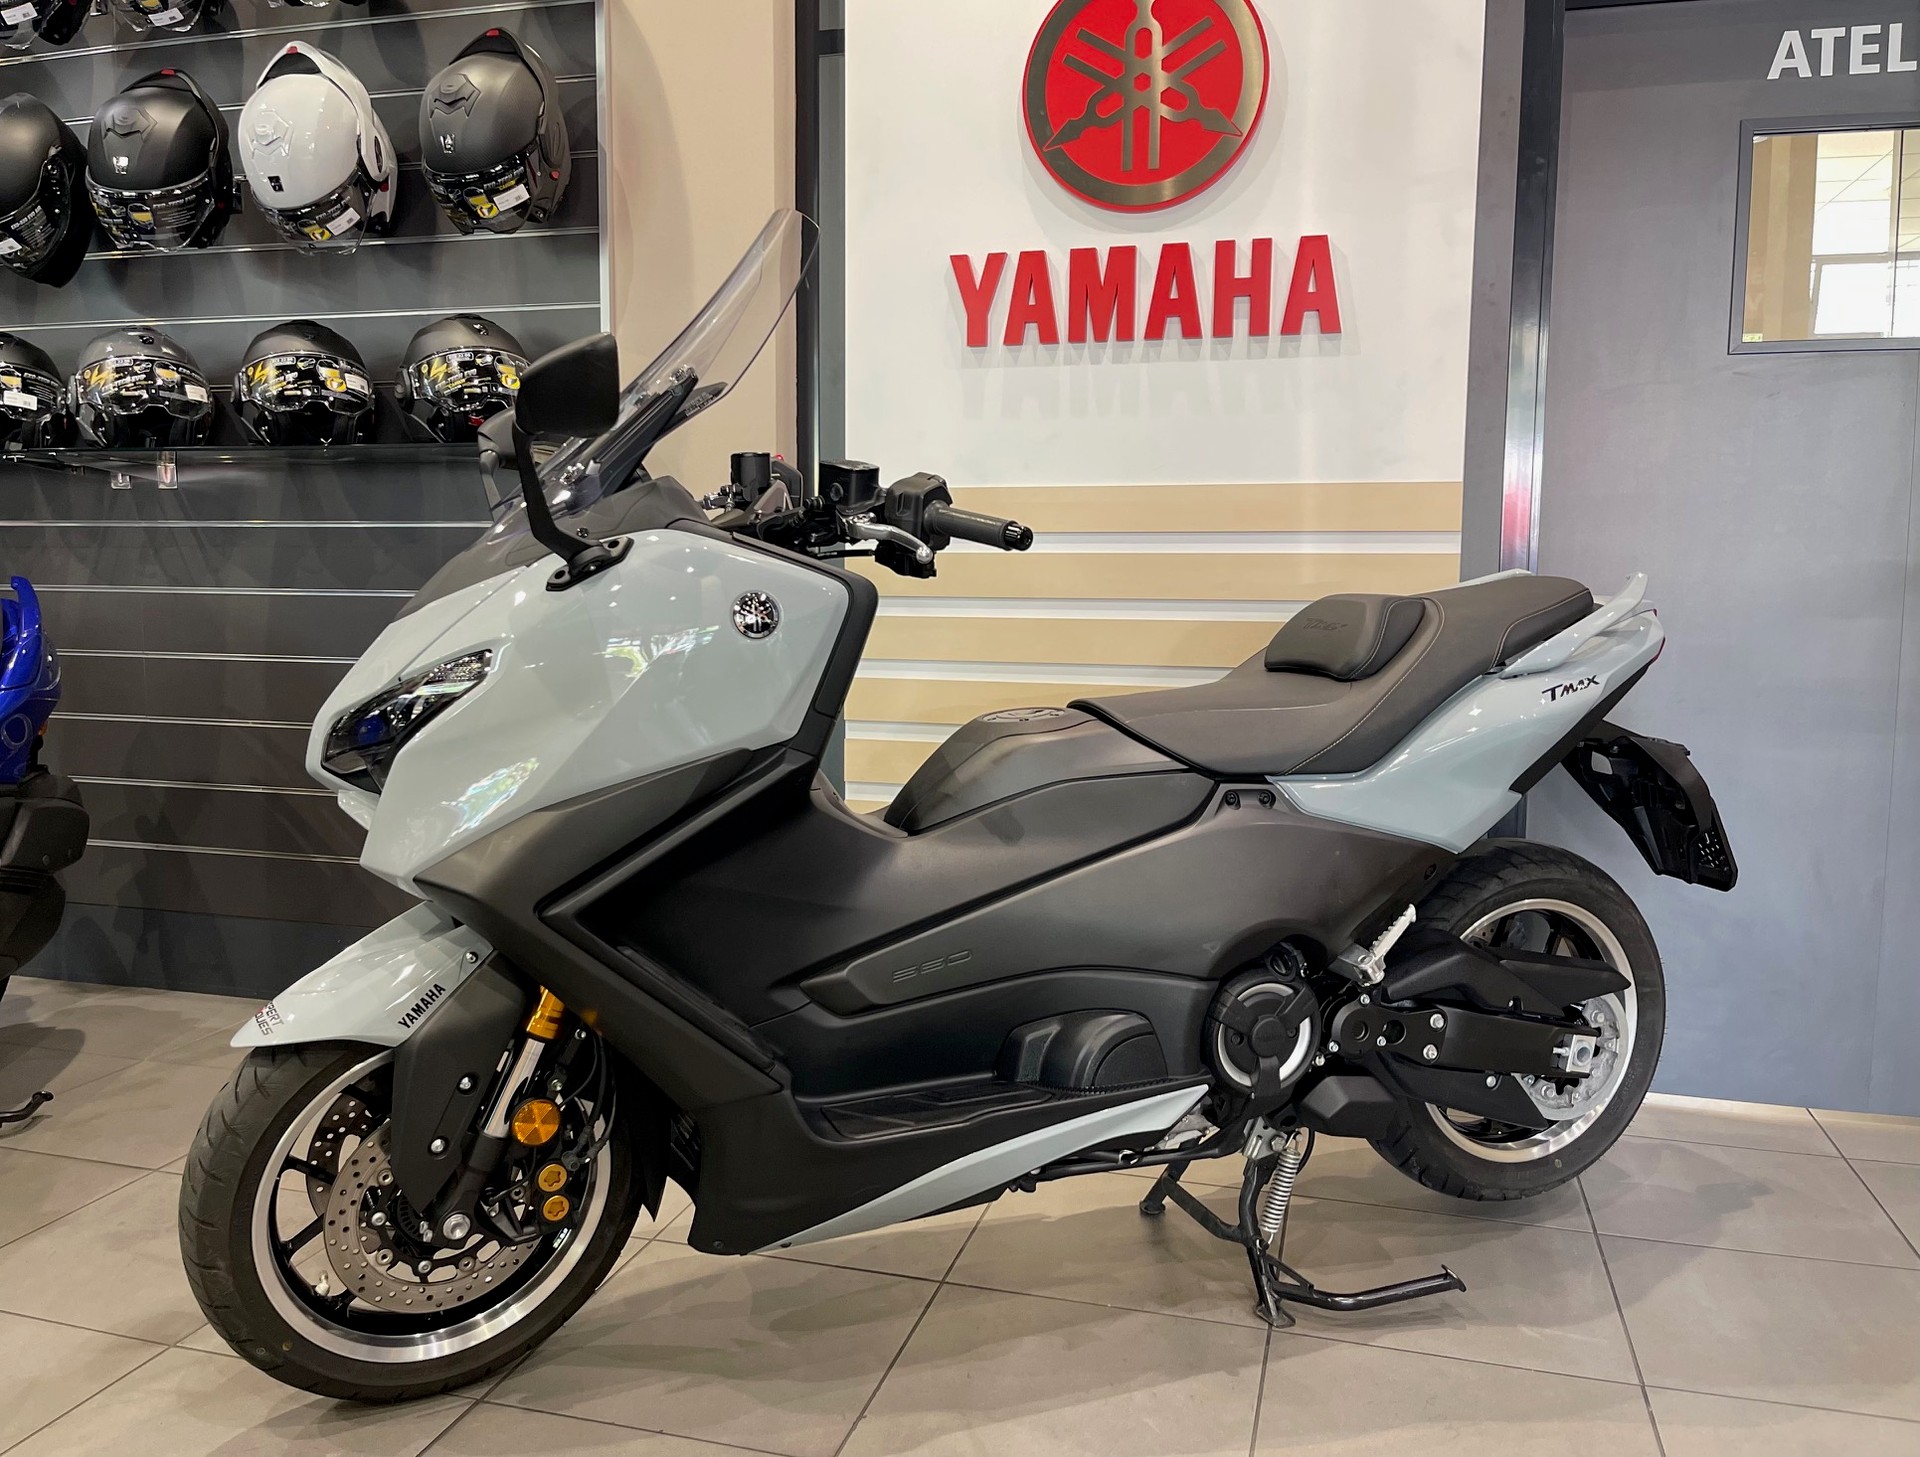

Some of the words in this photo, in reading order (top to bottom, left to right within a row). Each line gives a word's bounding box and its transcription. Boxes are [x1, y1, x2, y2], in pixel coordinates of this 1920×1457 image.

[1766, 22, 1918, 80] ATEL
[949, 234, 1342, 347] YAMAHA
[1541, 674, 1600, 702] TMAX
[891, 949, 973, 983] 560
[397, 983, 447, 1029] YAMAHA
